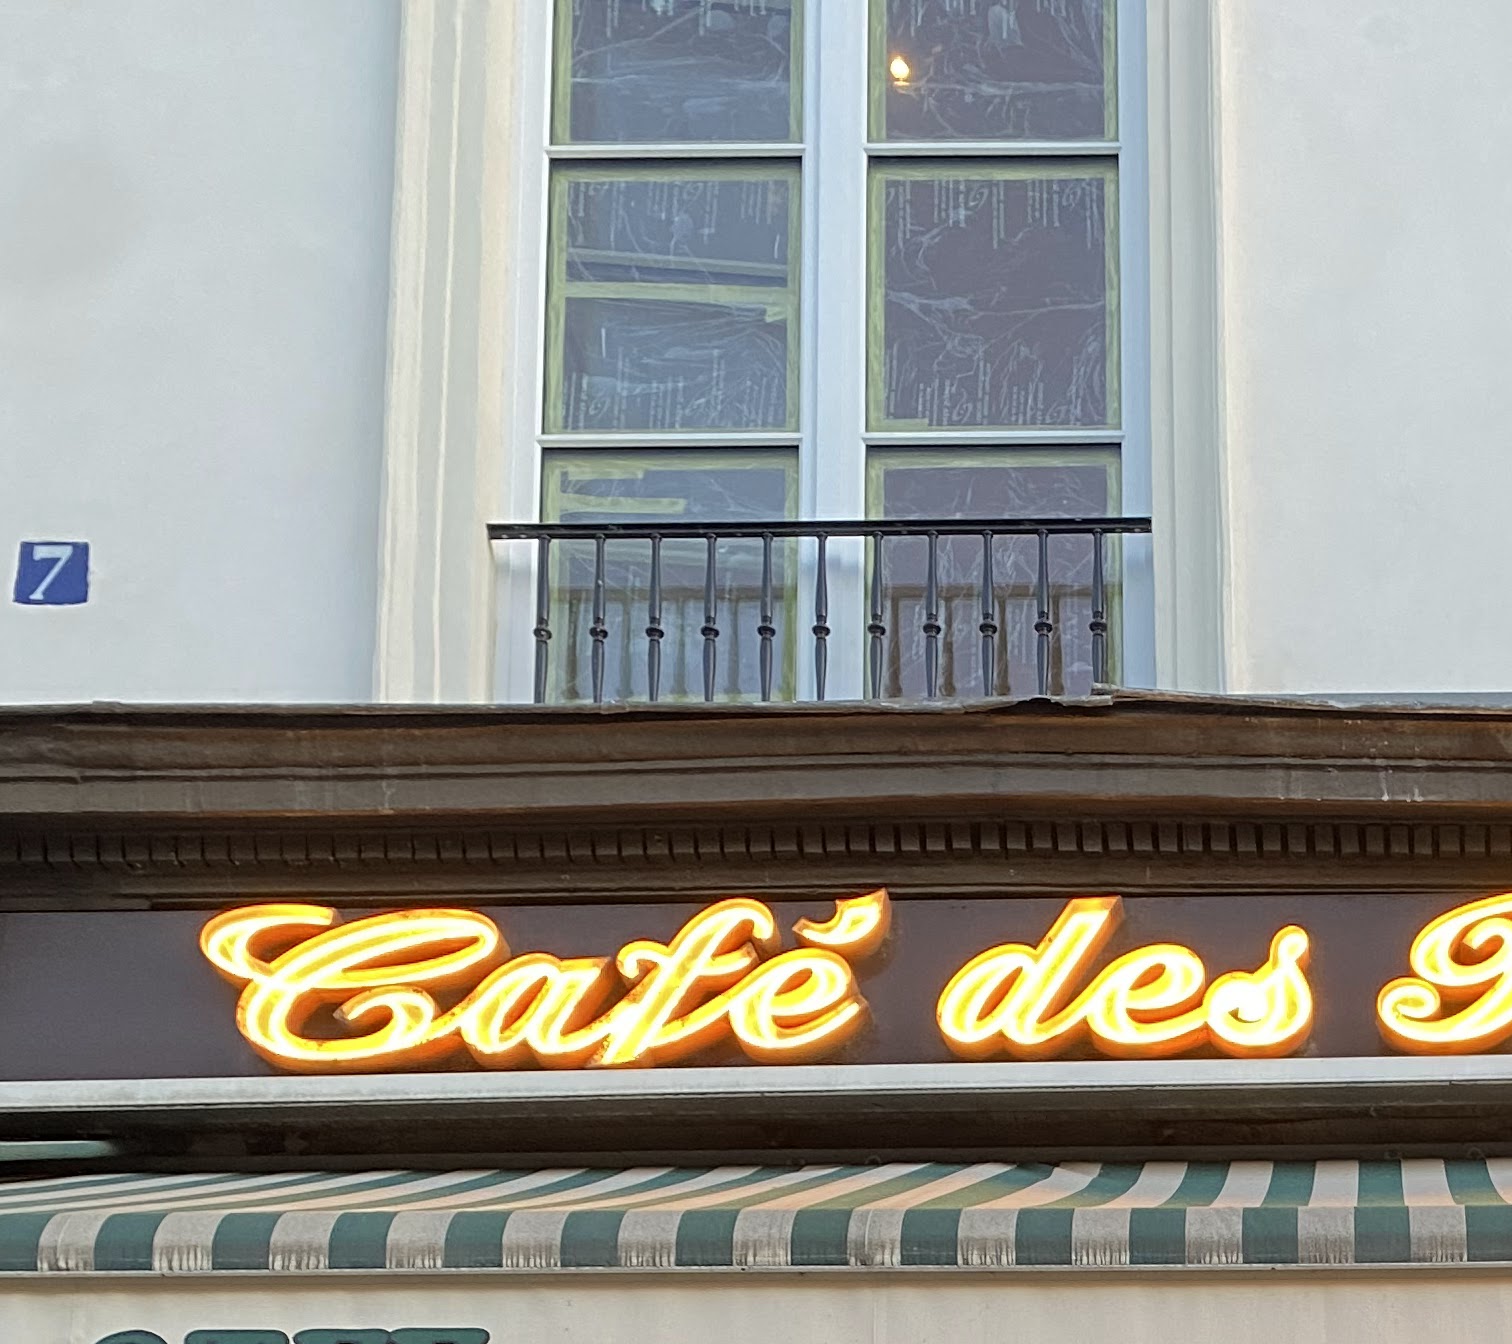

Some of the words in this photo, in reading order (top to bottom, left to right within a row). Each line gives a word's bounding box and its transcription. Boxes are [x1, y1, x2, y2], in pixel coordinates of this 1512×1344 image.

[29, 545, 73, 600] 7
[200, 889, 890, 1068] Café
[936, 896, 1314, 1062] des
